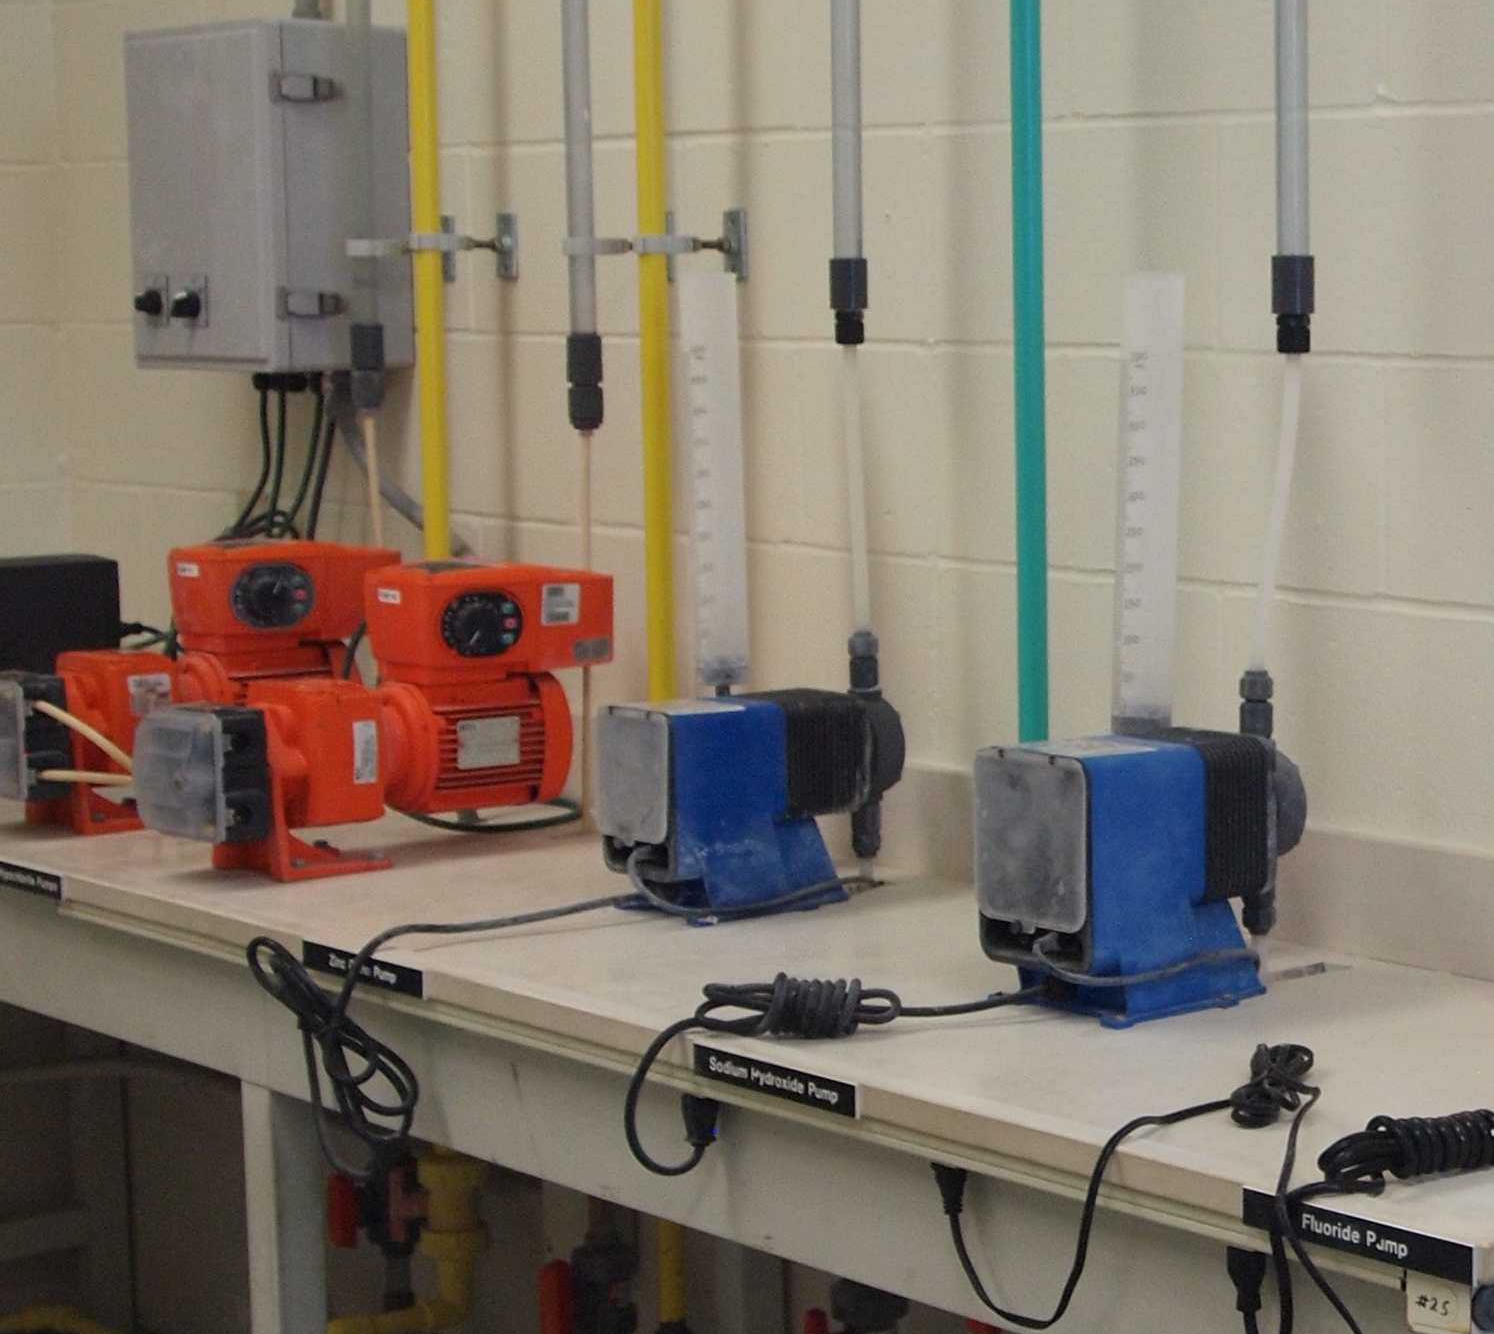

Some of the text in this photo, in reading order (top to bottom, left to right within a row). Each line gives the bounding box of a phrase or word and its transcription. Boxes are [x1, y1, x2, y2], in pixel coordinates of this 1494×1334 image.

[709, 1056, 839, 1105] Sodium Hydroxide Pump
[1301, 1213, 1409, 1258] Fluoride Pump
